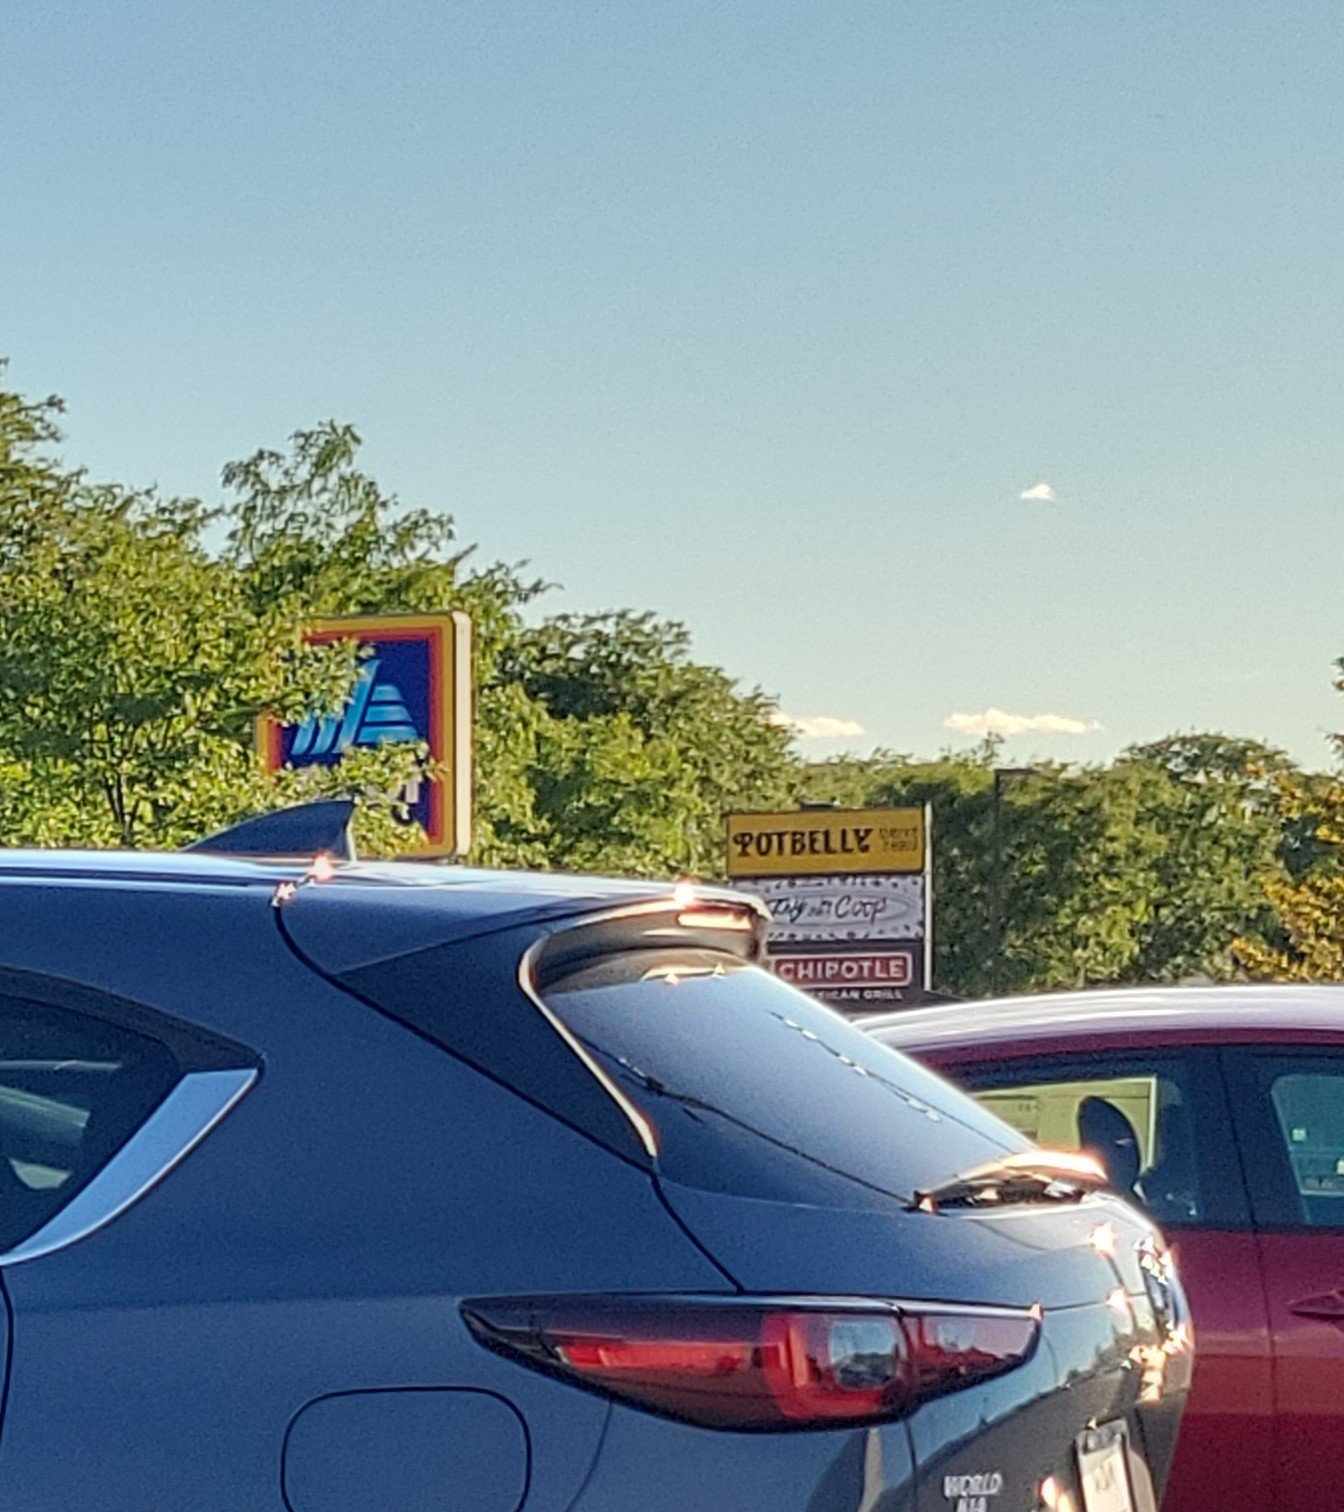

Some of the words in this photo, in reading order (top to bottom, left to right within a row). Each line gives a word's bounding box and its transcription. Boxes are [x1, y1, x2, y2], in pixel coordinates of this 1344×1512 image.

[732, 828, 874, 857] POTBELLY
[834, 895, 887, 925] Coop
[778, 958, 905, 980] CHIPOTLE
[943, 1472, 1003, 1497] WORLD
